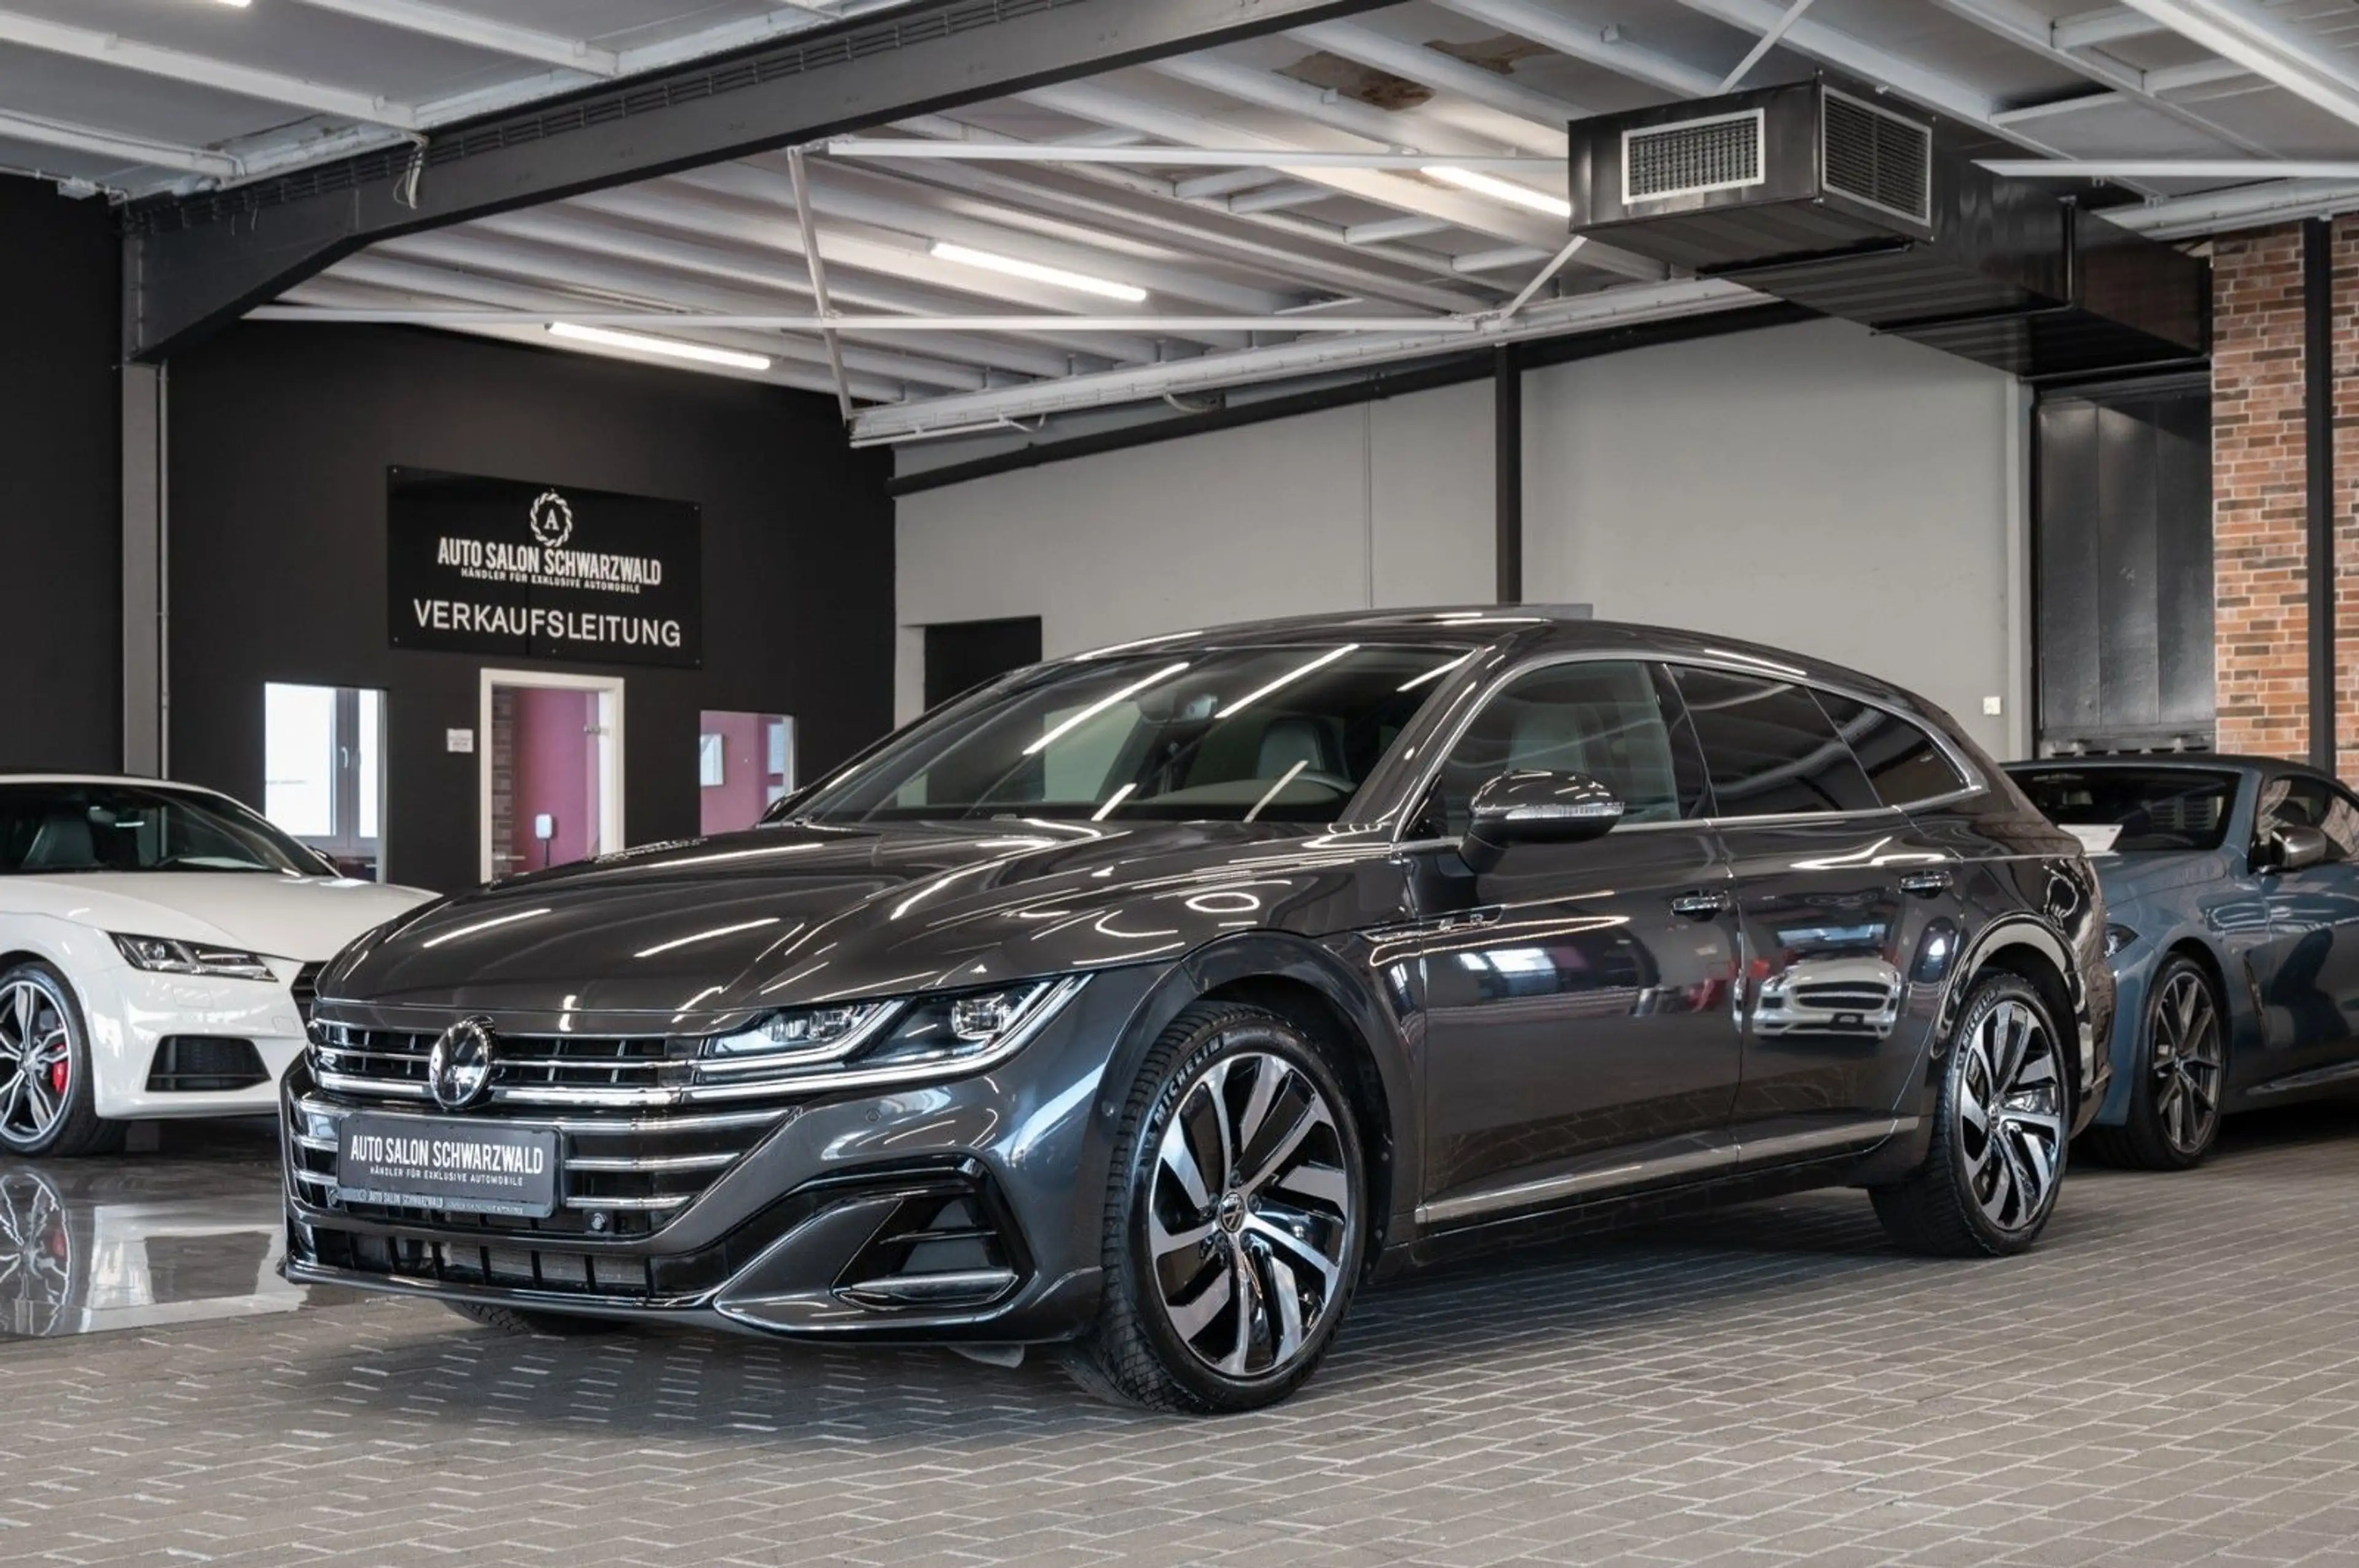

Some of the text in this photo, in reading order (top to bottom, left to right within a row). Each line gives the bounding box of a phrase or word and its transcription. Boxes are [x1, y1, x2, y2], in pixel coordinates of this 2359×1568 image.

[544, 509, 560, 531] A
[438, 537, 662, 585] AUTO SALON SCHWARZWALD
[461, 566, 640, 593] HÄNDLER FÜR EXKLUSIVE AUTOMOBILE
[413, 598, 681, 647] VERKAUFSLEITUNG
[1154, 1036, 1220, 1126] MICHELIN
[351, 1134, 544, 1174] AUTO SALON SCHWARZWALD
[370, 1166, 523, 1187] HÄNDLER FÜR EXKLUSIVE AUTOMOBILE
